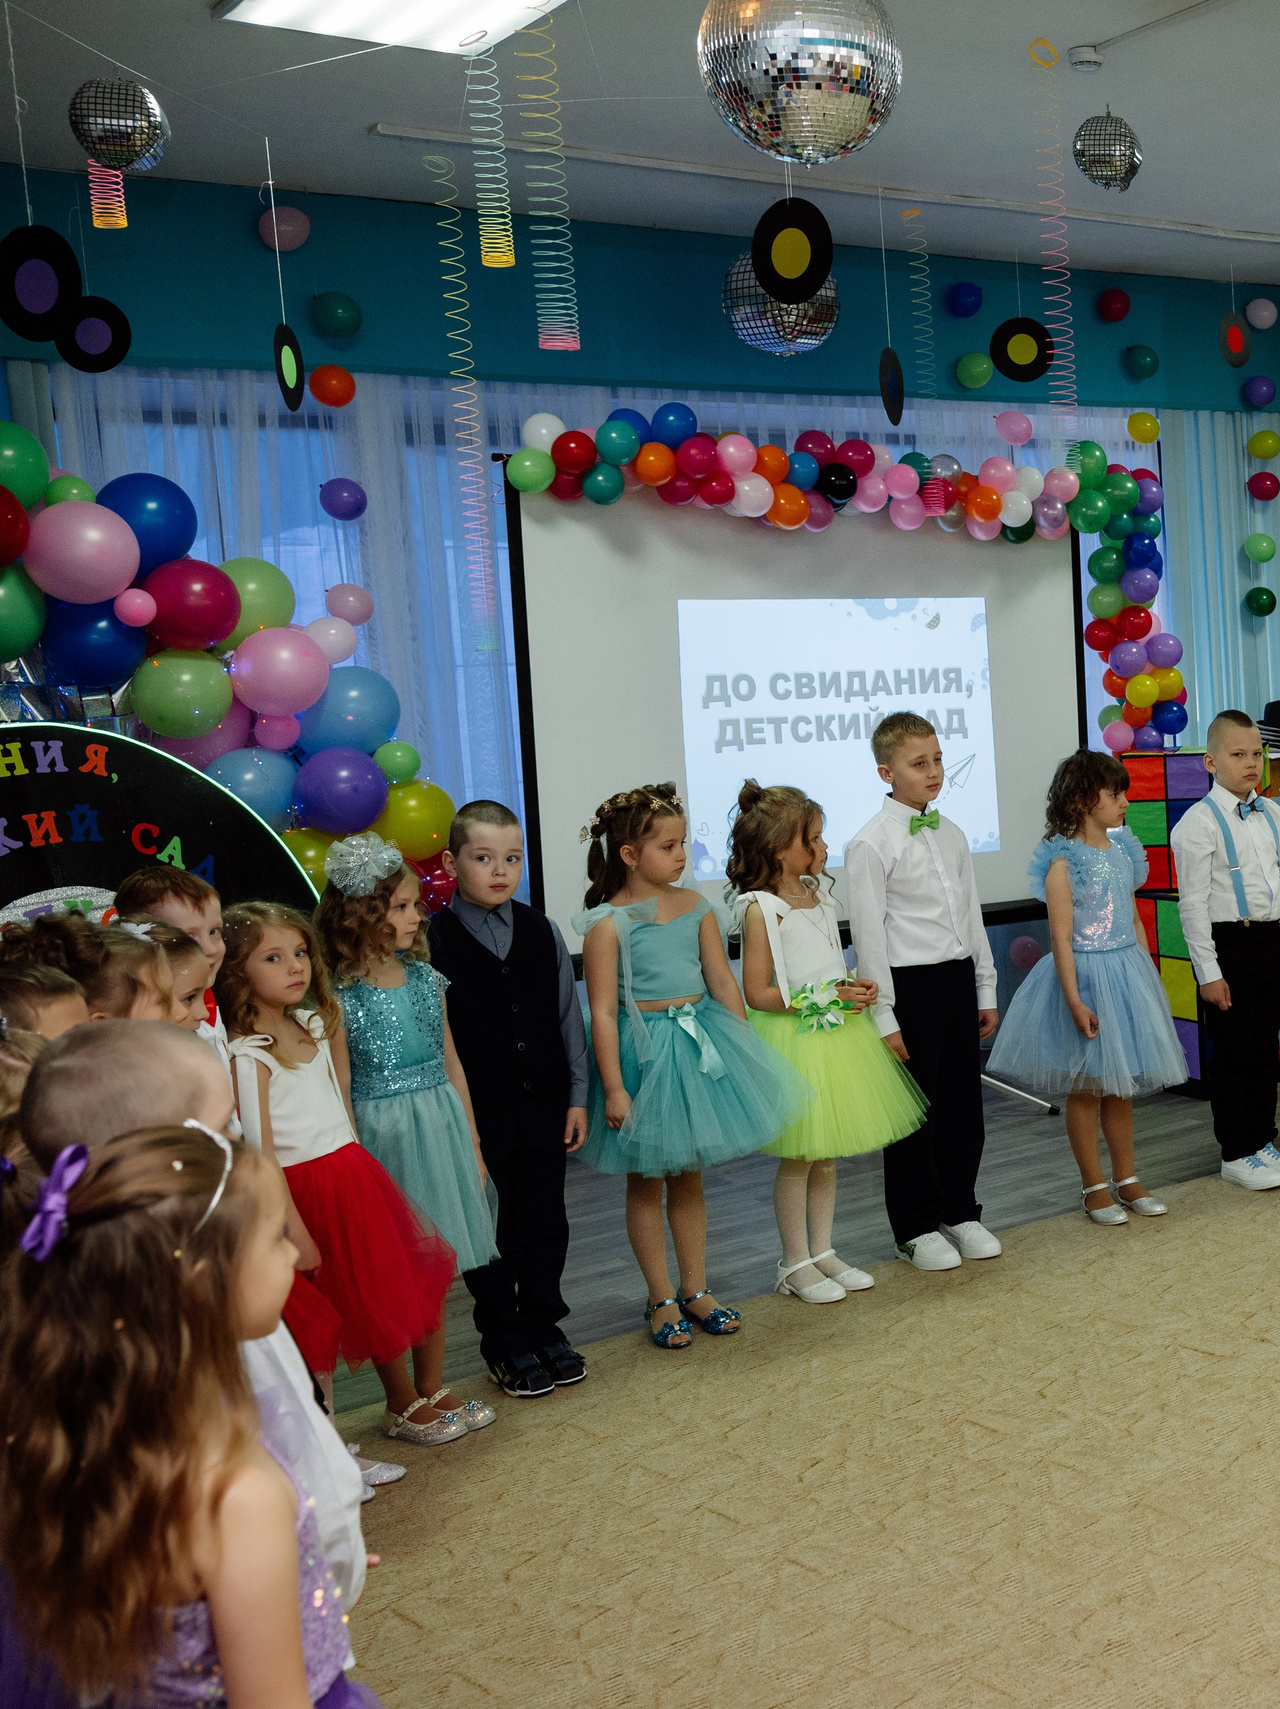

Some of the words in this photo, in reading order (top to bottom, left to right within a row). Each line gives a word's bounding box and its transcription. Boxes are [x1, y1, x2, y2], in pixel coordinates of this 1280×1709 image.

[702, 673, 757, 709] ДО
[769, 666, 974, 703] СВИДАНИЯ,
[925, 708, 969, 740] АД
